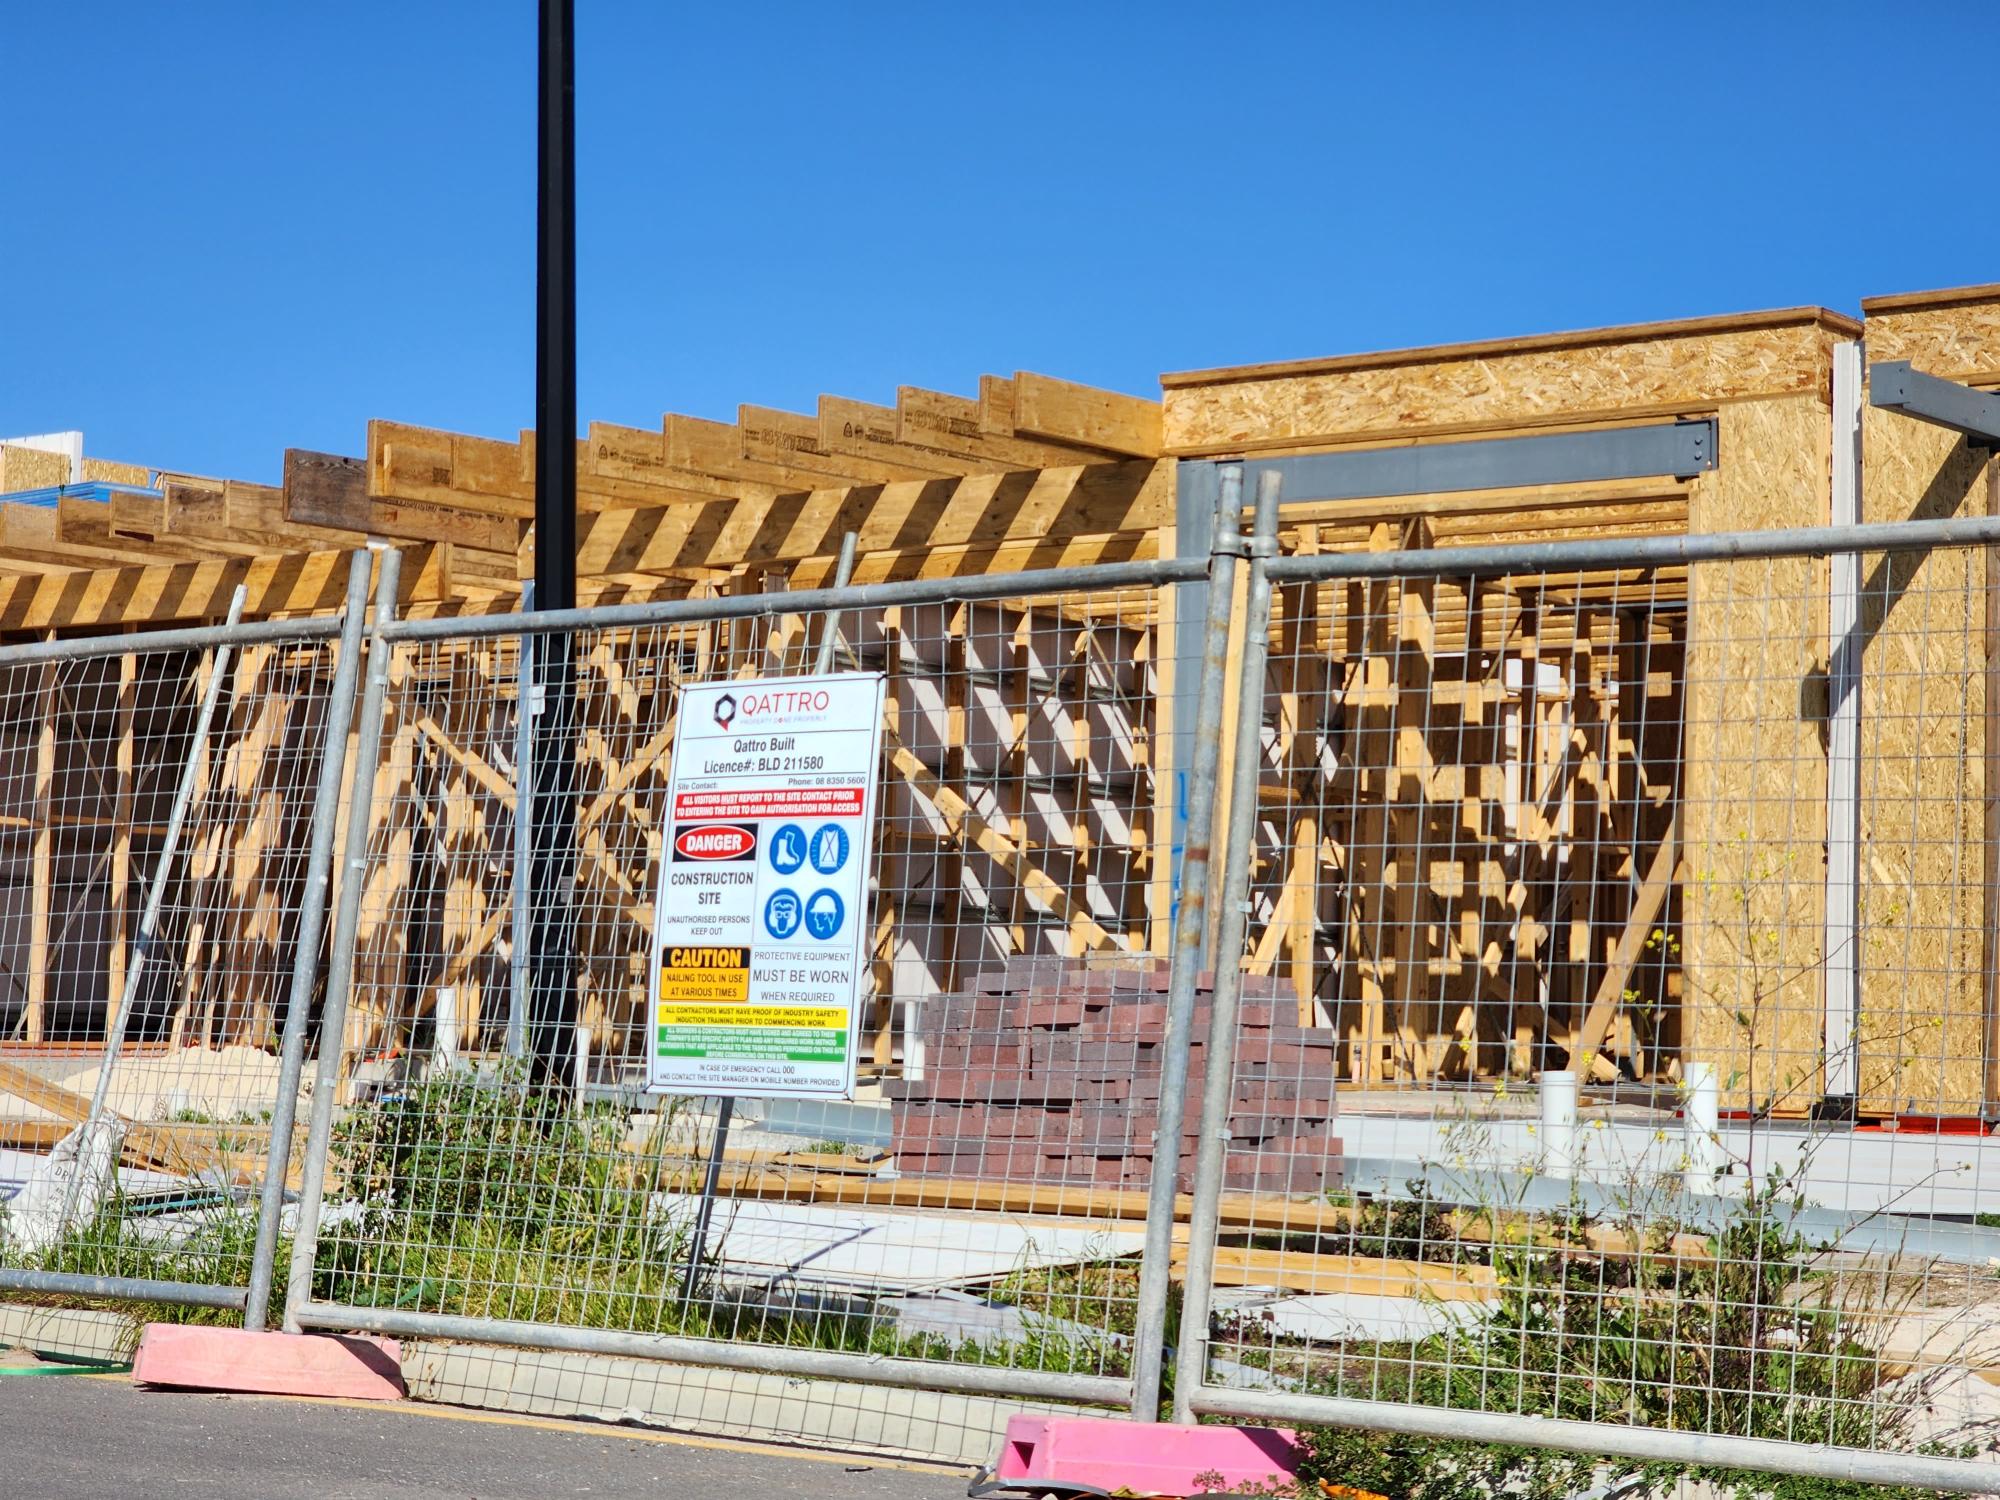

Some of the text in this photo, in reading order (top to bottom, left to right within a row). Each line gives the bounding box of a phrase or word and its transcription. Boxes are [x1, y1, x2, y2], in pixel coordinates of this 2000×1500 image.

[743, 691, 829, 716] QATTRO
[734, 737, 795, 753] Qattro Built
[704, 756, 824, 774] Licence#: BLD 211580
[677, 782, 690, 790] Site
[789, 775, 866, 786] Phone: 08 8350 5600
[683, 796, 694, 806] ALL
[721, 794, 737, 804] MUST
[738, 793, 763, 804] REPORT
[764, 793, 772, 803] TO
[774, 792, 786, 803] THE
[787, 792, 801, 802] SITE
[802, 791, 832, 802] CONTACT
[834, 790, 855, 801] PRIOR
[676, 802, 860, 817] TO ENTERING THE SITE TO GAIN AUTHORISATION FOR ACCESS
[686, 834, 743, 852] DANGER
[671, 872, 754, 885] CONSTRUCTION
[698, 893, 721, 905] SITE
[667, 915, 751, 924] UNAUTHORISED PERSONS
[670, 948, 742, 967] CAUTION
[754, 952, 850, 961] PROTECTIVE EQUIPMENT
[667, 974, 743, 983] NAILING TOOL IN USE
[753, 970, 849, 983] MUST BE WORN
[671, 987, 737, 997] AT VARIOUS TIMES
[761, 992, 835, 1002] WHEN REQUIRED
[731, 1065, 765, 1073] EMERGENCY
[783, 1066, 795, 1074] 000
[722, 1075, 749, 1083] MANAGER
[810, 1078, 840, 1086] PROVIDED
